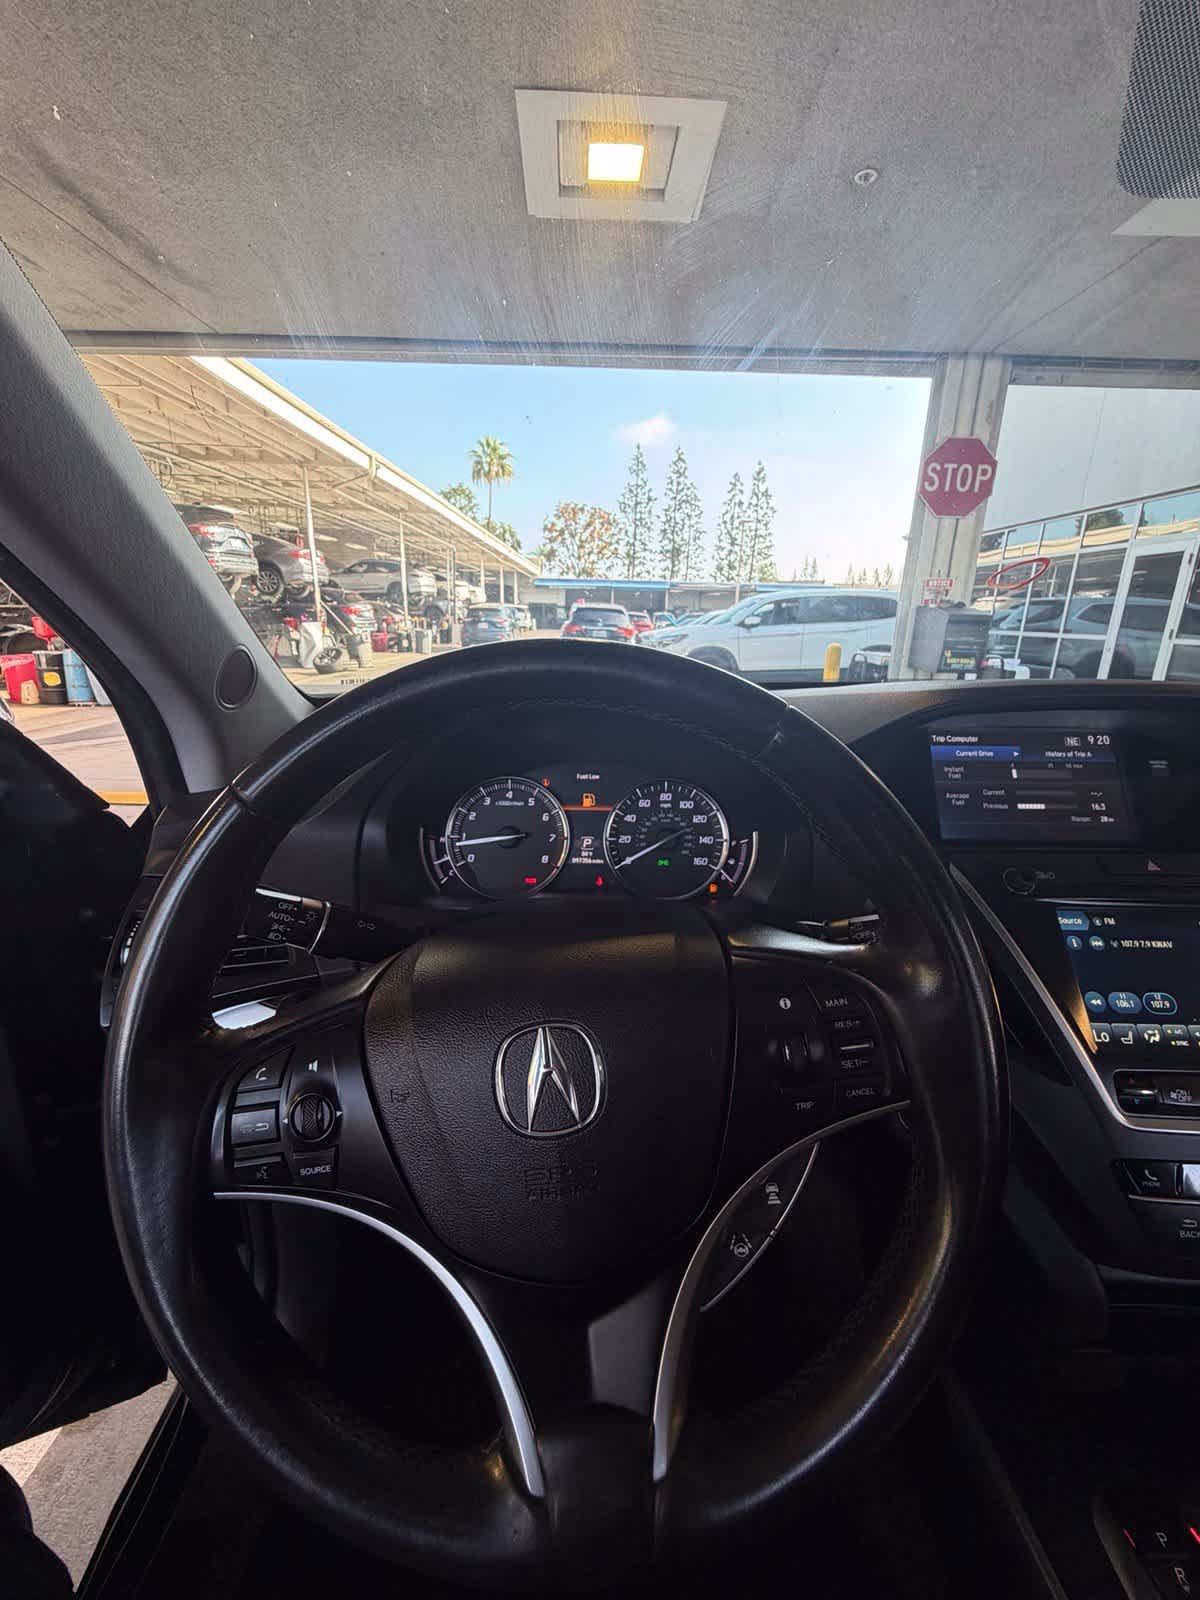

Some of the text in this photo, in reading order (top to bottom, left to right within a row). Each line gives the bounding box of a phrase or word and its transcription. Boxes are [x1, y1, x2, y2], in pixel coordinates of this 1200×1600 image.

[924, 463, 993, 493] STOP
[932, 735, 978, 743] Trip Computer
[505, 791, 513, 799] 4
[660, 793, 672, 801] 80
[946, 792, 970, 800] Average
[483, 797, 491, 806] 3
[528, 798, 535, 806] 5
[679, 801, 694, 809] 100
[952, 799, 965, 807] Fuel
[468, 812, 477, 821] 2
[542, 813, 549, 821] 6
[692, 815, 707, 823] 120
[549, 834, 556, 842] 7
[583, 838, 592, 848] P
[467, 854, 475, 862] 0
[268, 912, 291, 921] AUTO
[1058, 917, 1082, 925] Source
[825, 998, 848, 1007] MAIN
[1116, 1000, 1134, 1008] 106.1
[1150, 1001, 1169, 1009] 107.9
[1093, 1029, 1109, 1043] LO
[847, 1088, 874, 1097] CANCEL
[795, 1101, 815, 1110] TRIP
[299, 1165, 332, 1176] SOURCE
[1156, 1532, 1168, 1549] P
[1174, 1567, 1189, 1585] R
